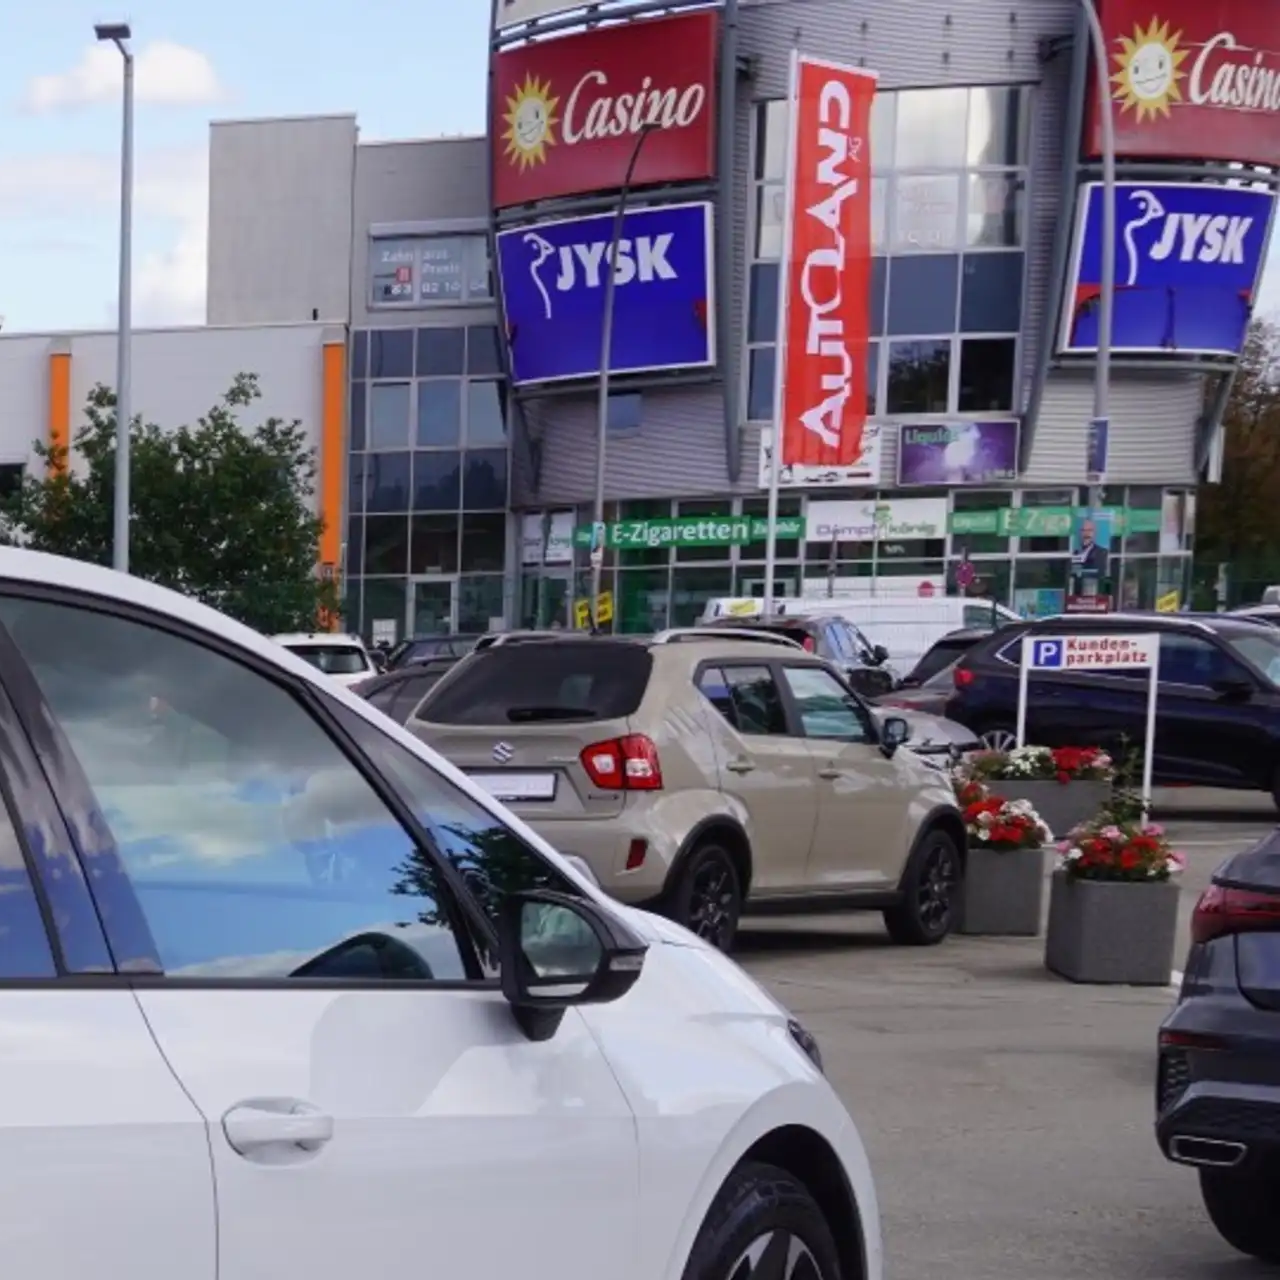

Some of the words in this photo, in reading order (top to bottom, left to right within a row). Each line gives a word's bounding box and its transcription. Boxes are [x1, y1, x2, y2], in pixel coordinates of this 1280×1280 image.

[561, 70, 706, 145] Casino
[1149, 213, 1253, 264] JYSK
[556, 232, 679, 291] JYSK
[799, 79, 859, 449] AUTOLAND
[611, 520, 749, 546] E-Zigaretten
[1039, 642, 1058, 665] P
[1066, 650, 1147, 665] parkplatz
[1067, 638, 1137, 651] Kunden-
